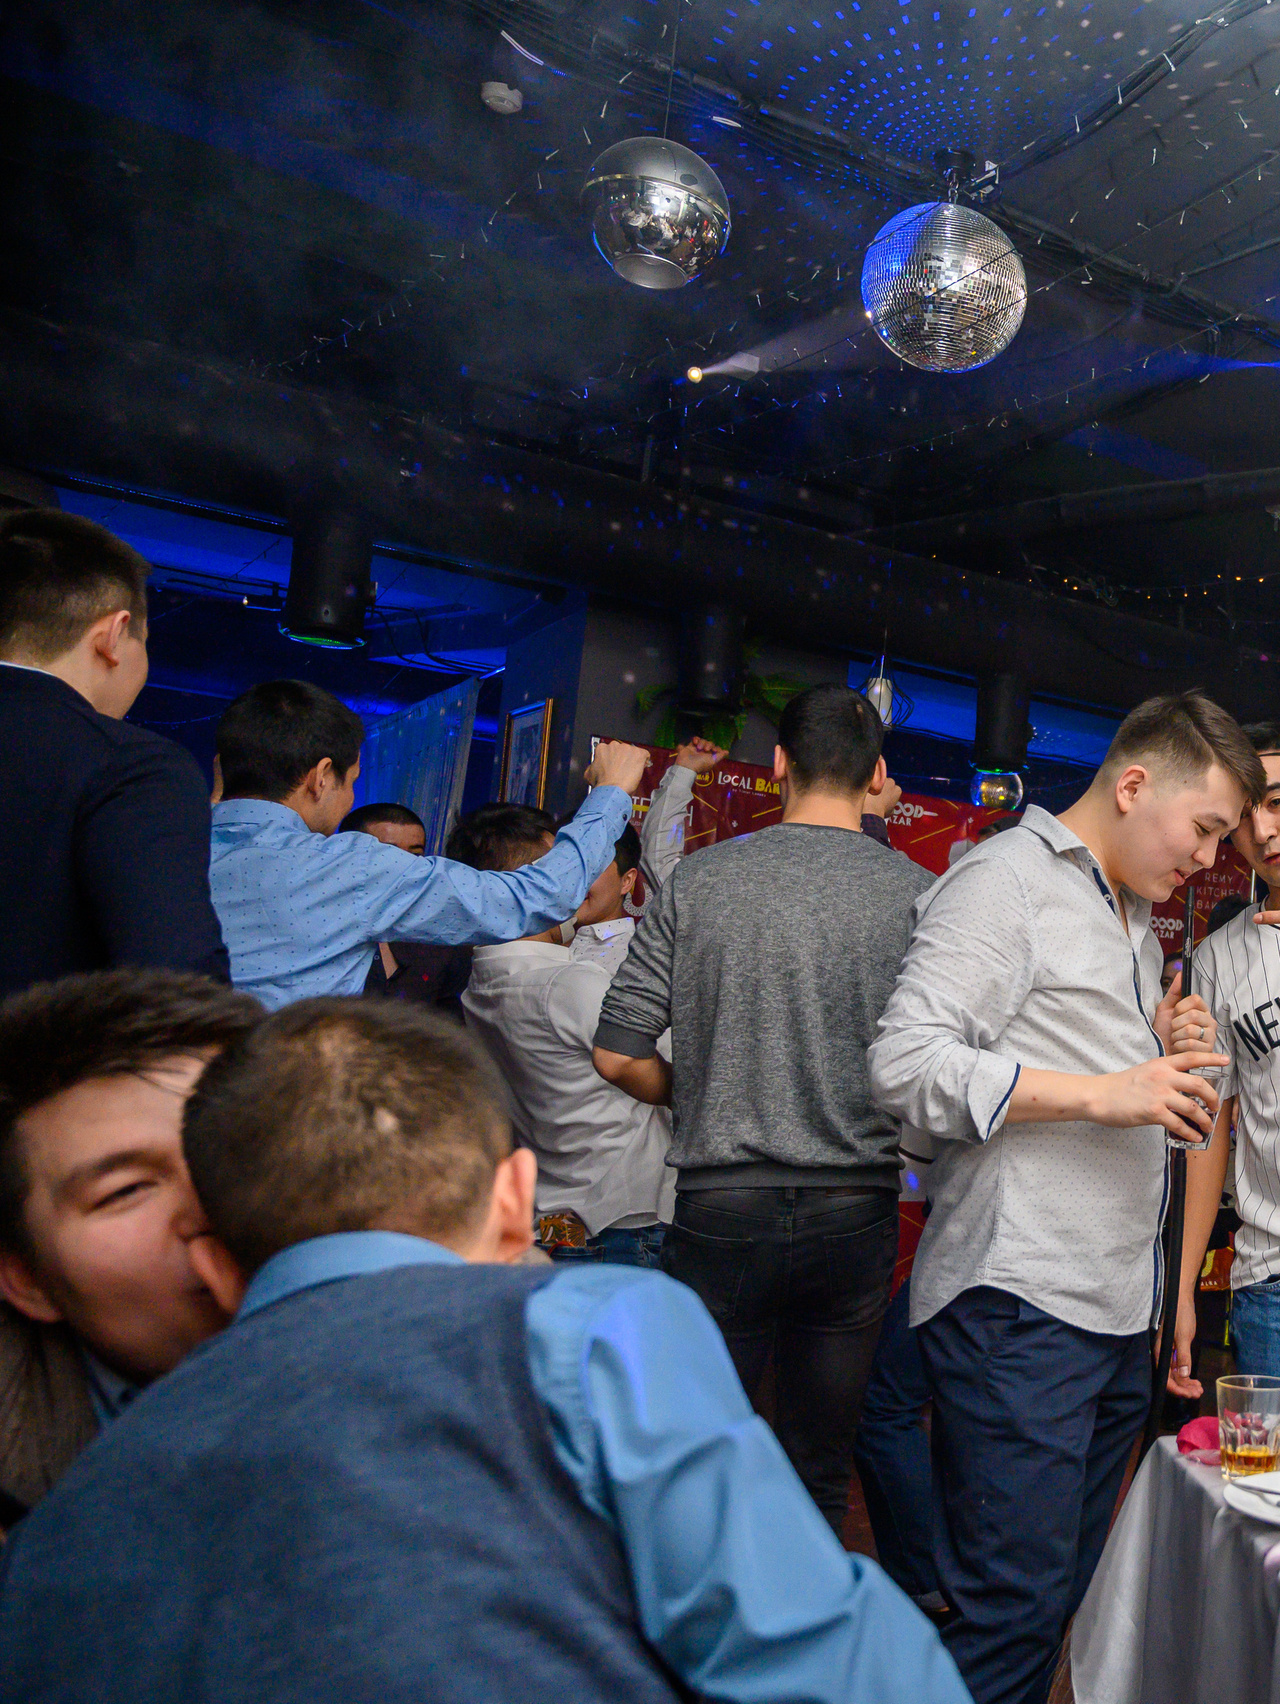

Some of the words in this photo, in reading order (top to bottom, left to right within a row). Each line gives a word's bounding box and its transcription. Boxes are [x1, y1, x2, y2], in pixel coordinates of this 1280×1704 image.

[755, 778, 780, 795] BAR
[1204, 872, 1234, 884] REMY
[1196, 886, 1241, 898] KITCHE
